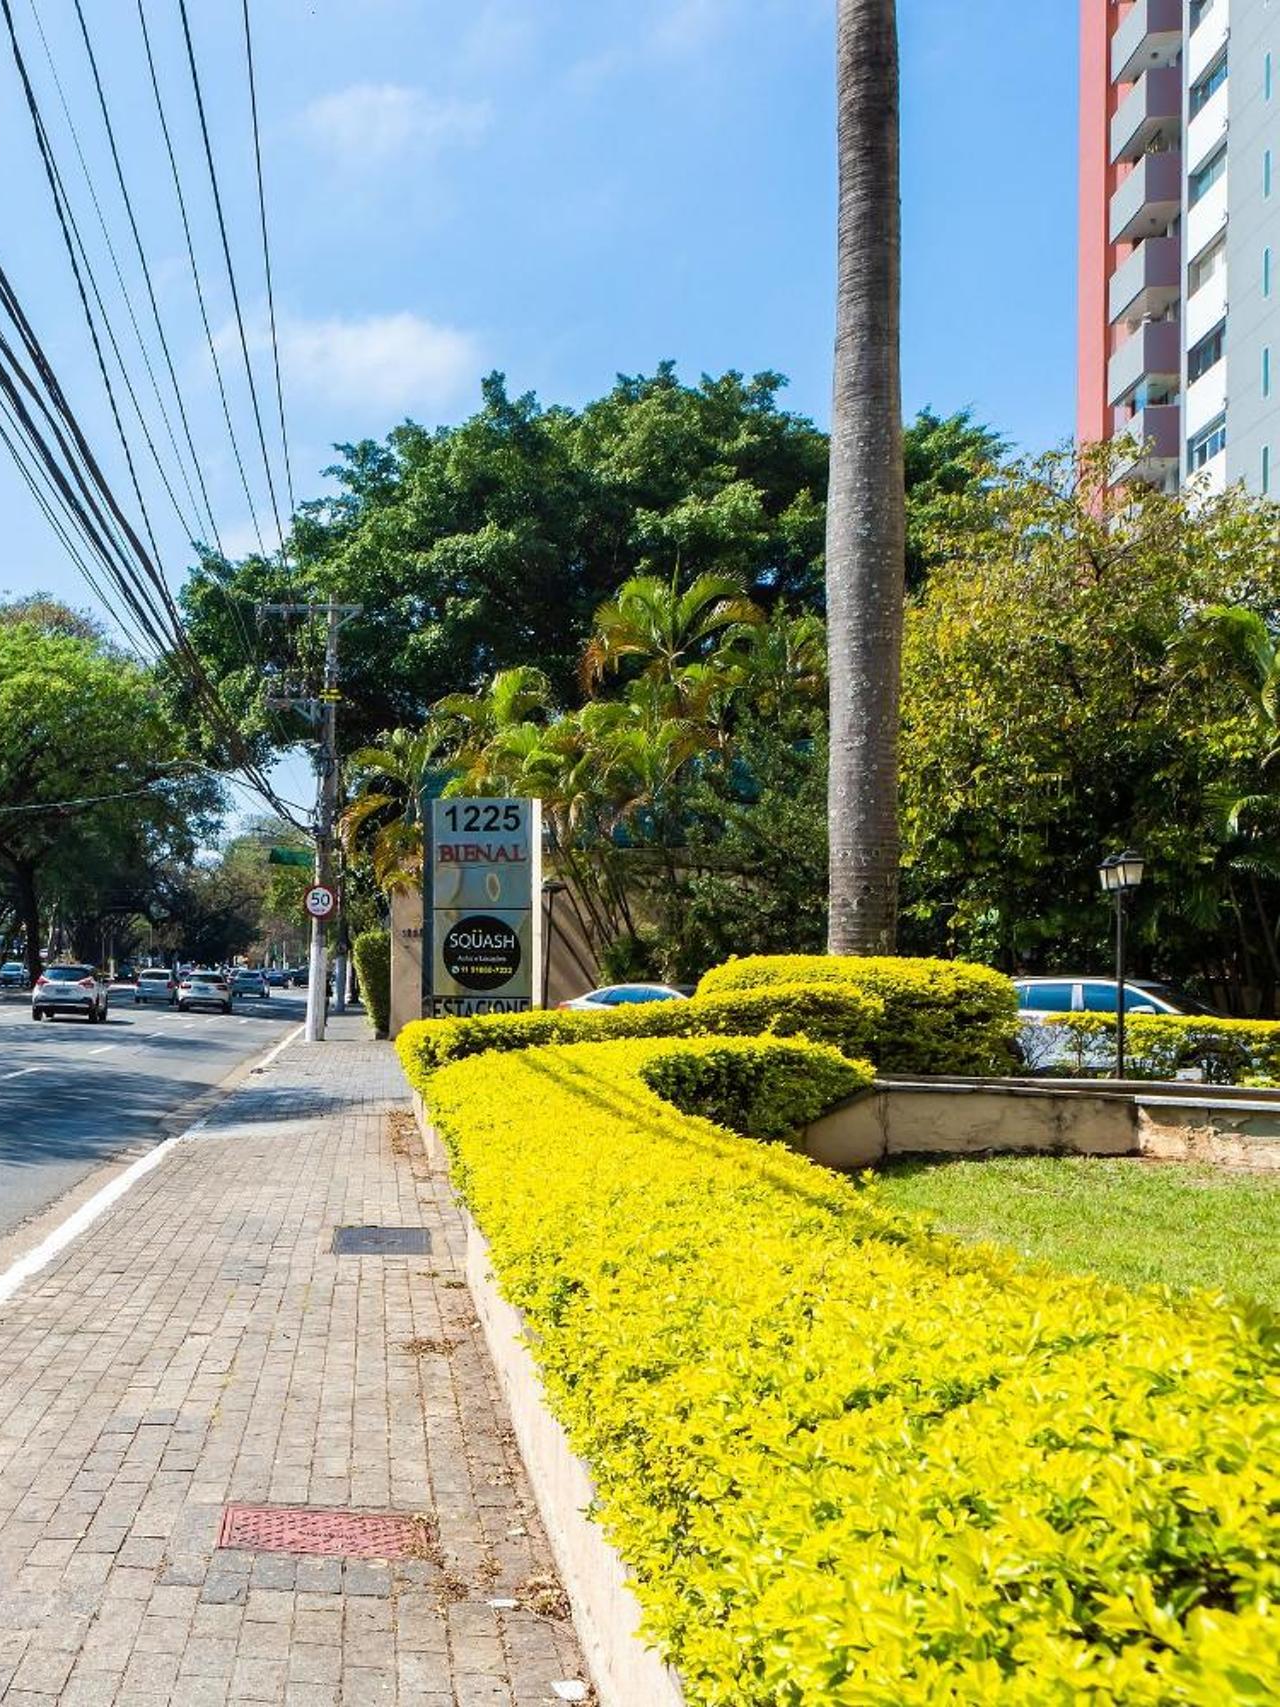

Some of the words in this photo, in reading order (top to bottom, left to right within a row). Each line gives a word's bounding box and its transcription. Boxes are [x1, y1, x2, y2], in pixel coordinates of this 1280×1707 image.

[445, 805, 521, 832] 1225
[438, 844, 527, 862] BIENAL
[311, 892, 330, 907] 50
[449, 929, 515, 949] SQÜASH
